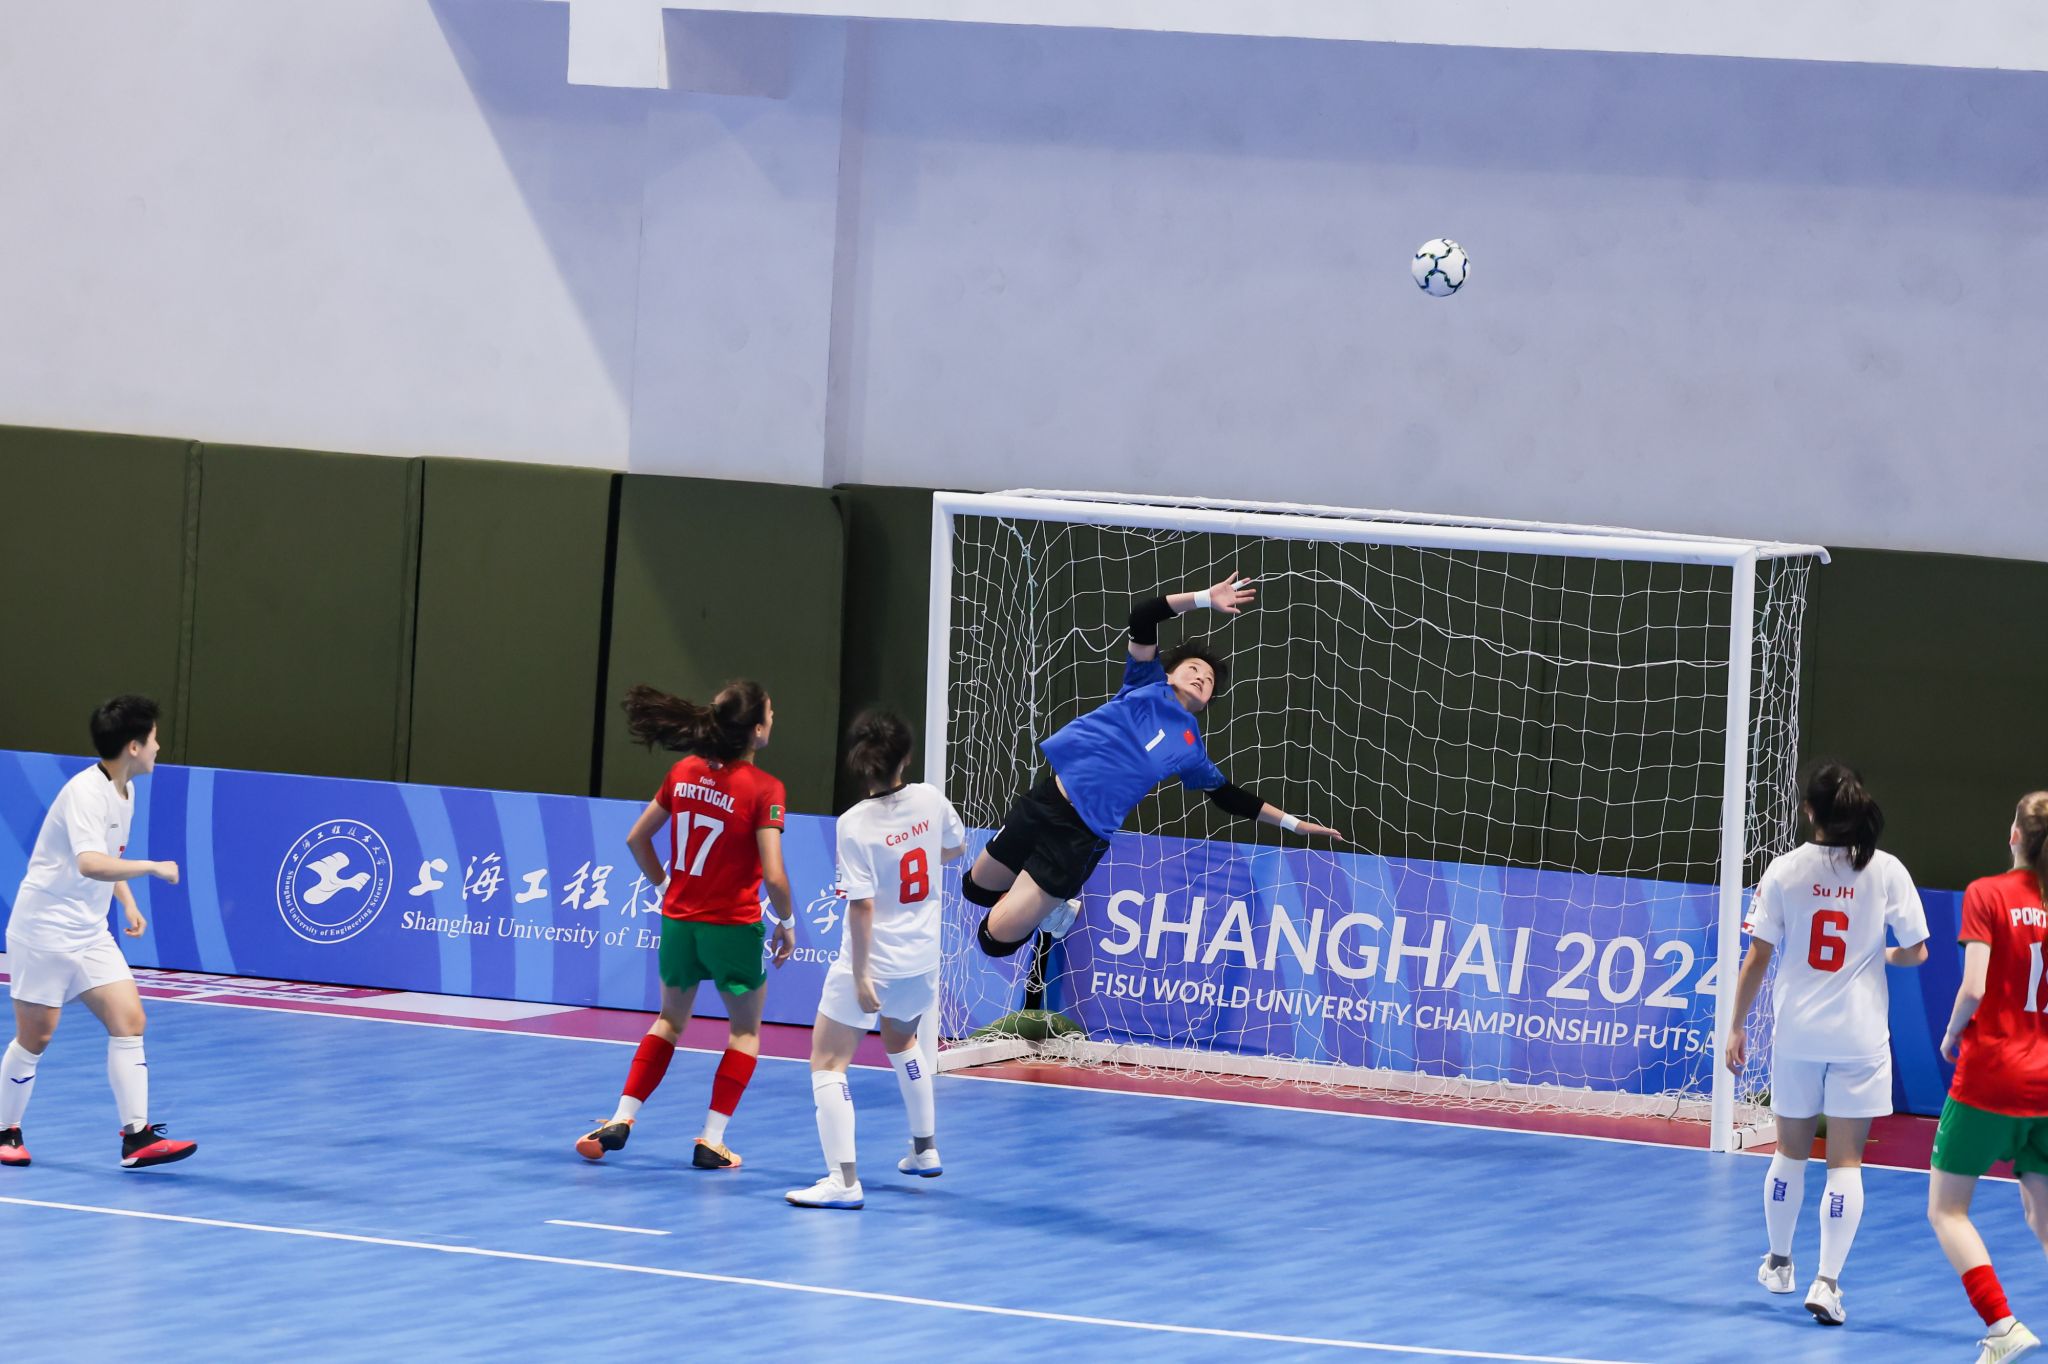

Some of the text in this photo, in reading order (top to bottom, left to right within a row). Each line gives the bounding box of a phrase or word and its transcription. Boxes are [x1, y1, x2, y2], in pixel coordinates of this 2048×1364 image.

[1144, 729, 1166, 752] 1
[673, 781, 735, 814] PORTUGAL
[674, 810, 724, 877] 17
[885, 819, 930, 847] Cao MY
[898, 847, 930, 904] 8
[1812, 884, 1854, 899] Su JH
[401, 911, 491, 938] Shanghai
[497, 918, 600, 950] University
[604, 927, 630, 947] of
[1099, 889, 1531, 995] SHANGHAI
[1807, 909, 1850, 973] 6
[763, 938, 839, 964] Sence
[1091, 971, 1147, 999] FISU
[1153, 977, 1250, 1009] WORLD
[1256, 988, 1412, 1026] UNIVERSITY
[1416, 1005, 1628, 1047] CHAMPIONSHIP
